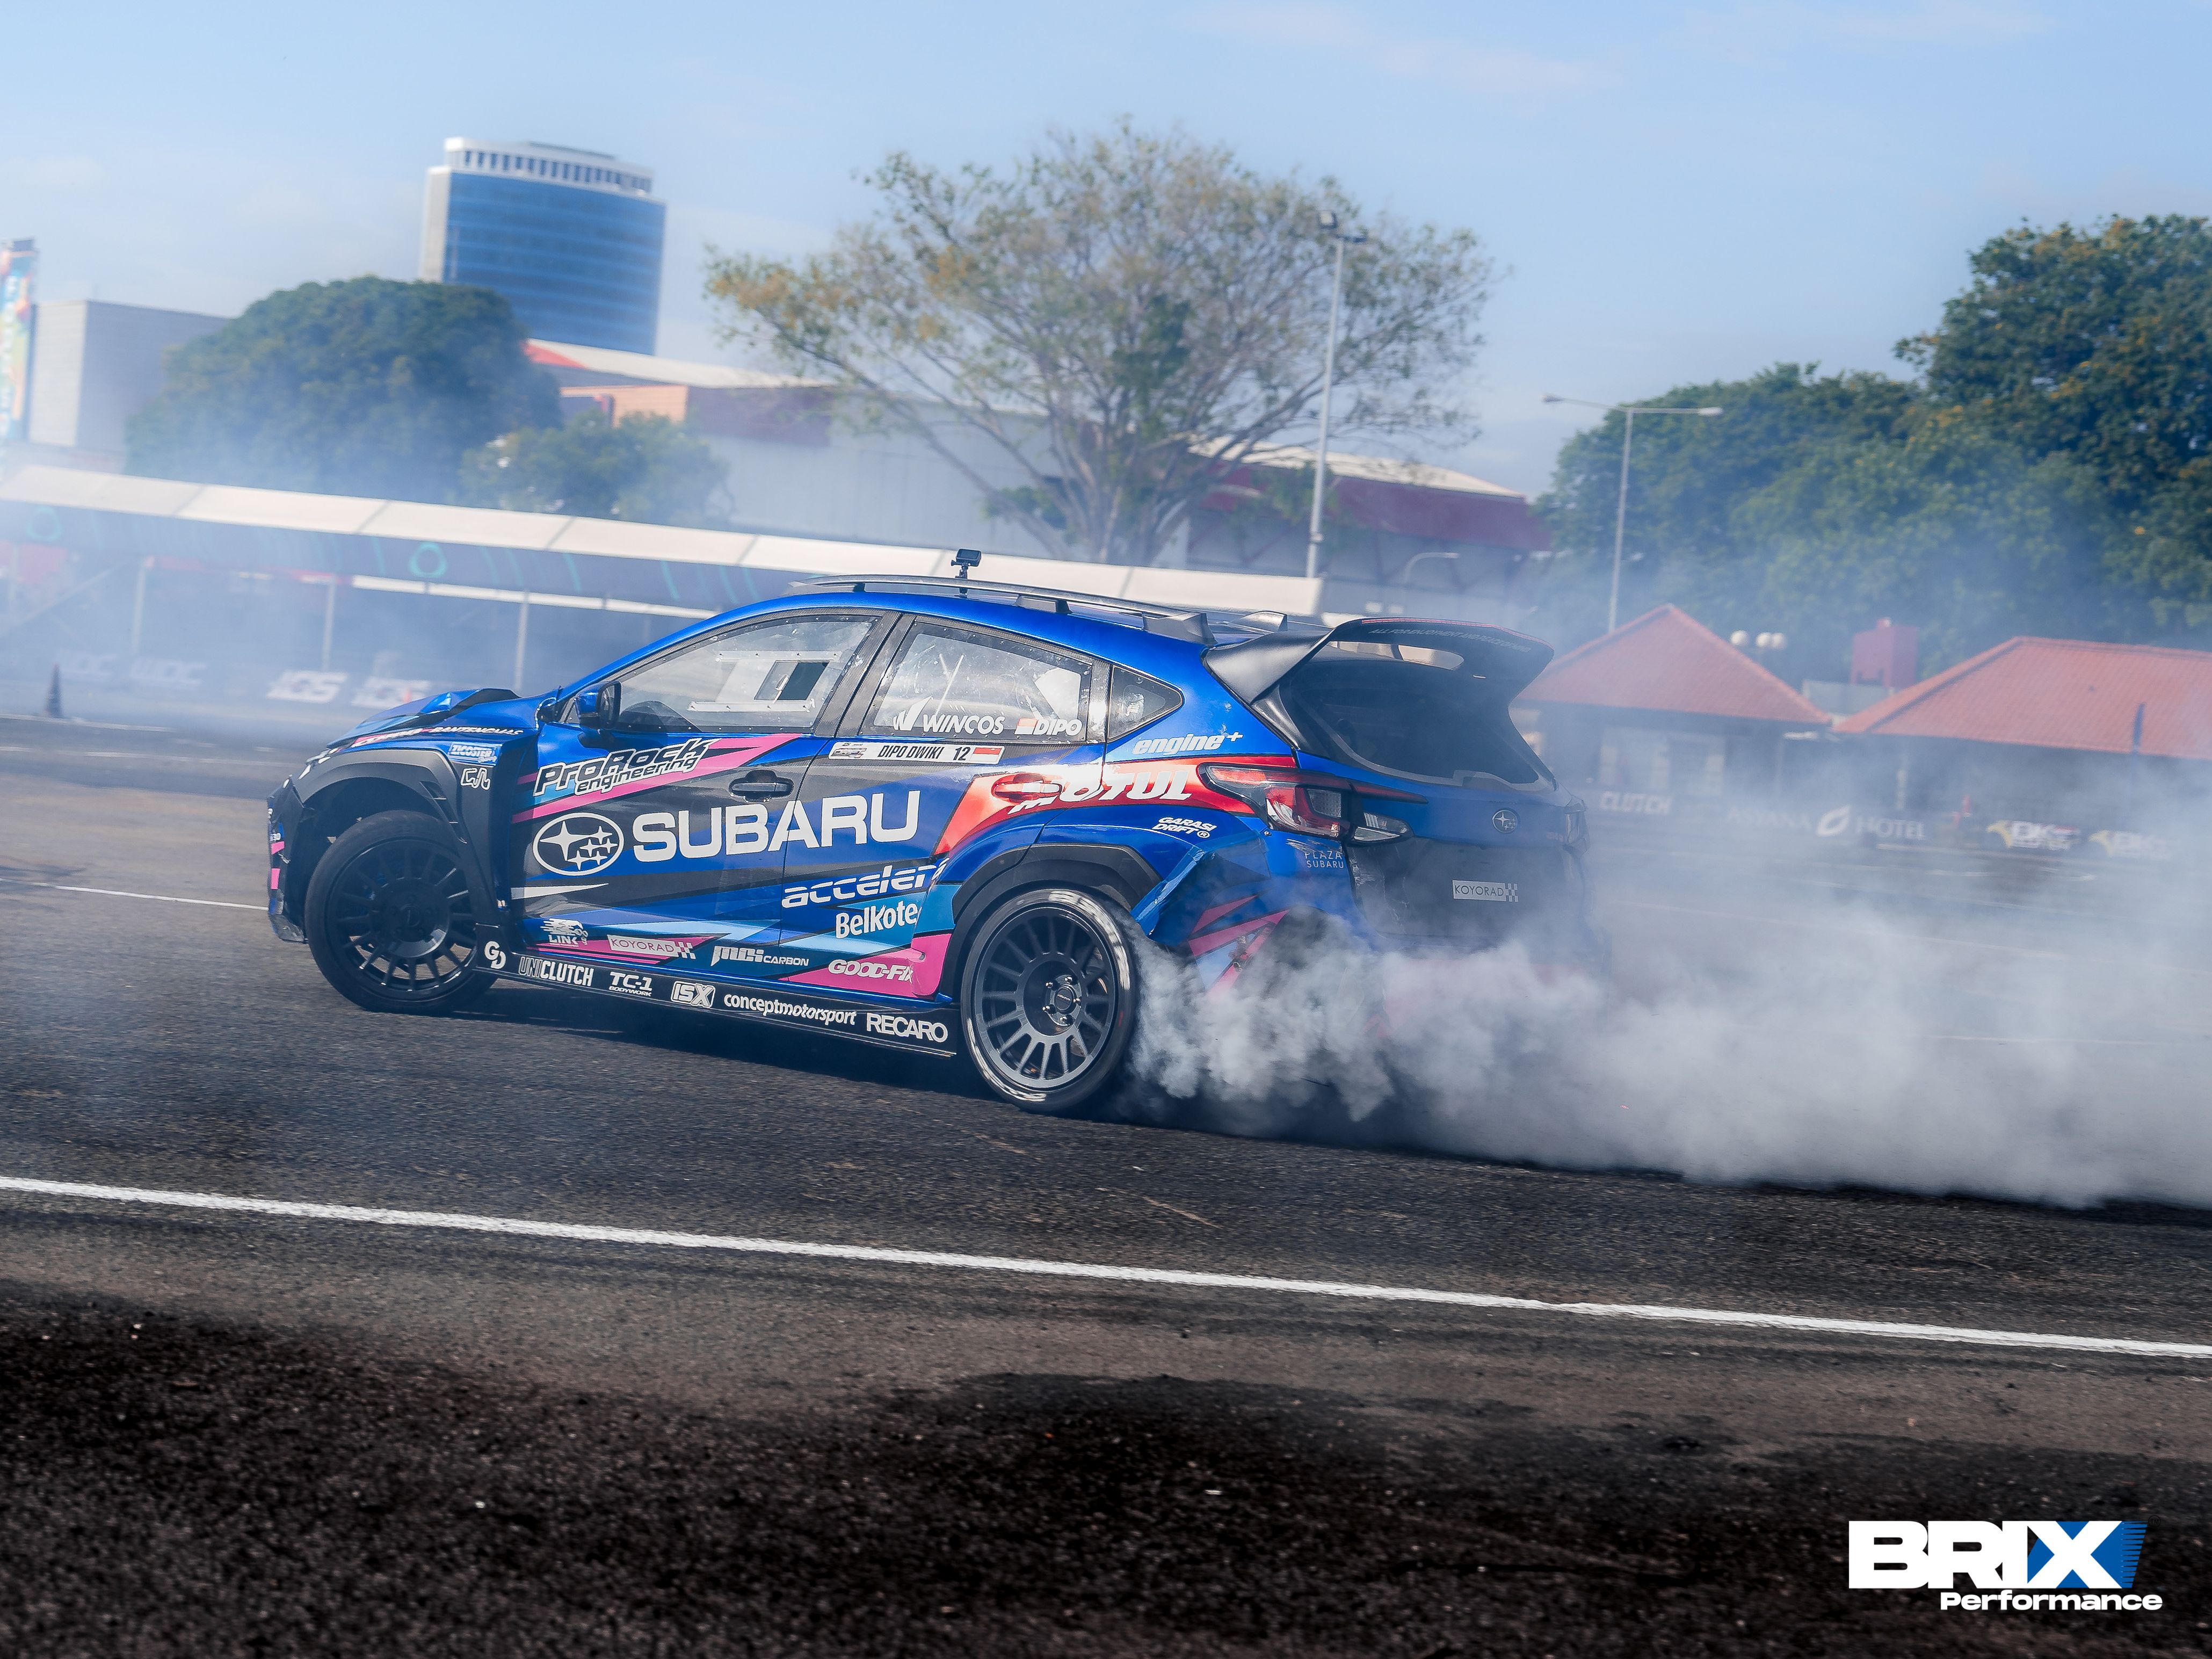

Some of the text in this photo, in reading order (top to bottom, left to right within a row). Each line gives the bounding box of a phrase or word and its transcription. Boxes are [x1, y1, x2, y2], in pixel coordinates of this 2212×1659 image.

[923, 714, 1005, 735] WINCOS
[1032, 719, 1083, 736] DIPO
[877, 745, 907, 758] DIPO
[906, 746, 944, 759] DWIKI
[953, 747, 971, 761] 12
[575, 757, 701, 795] engineering
[632, 789, 920, 863] SUBARU
[1158, 817, 1217, 831] GARASI
[1307, 860, 1344, 868] SUBARU
[1454, 885, 1504, 897] KOYORAD
[836, 901, 918, 939] Belkote
[611, 939, 675, 953] KOYORAD
[763, 955, 809, 966] CARBON
[610, 972, 653, 991] TC-1
[608, 986, 652, 997] BODYWORK
[724, 994, 857, 1026] conceptmotorsport
[866, 1012, 948, 1043] RECARO
